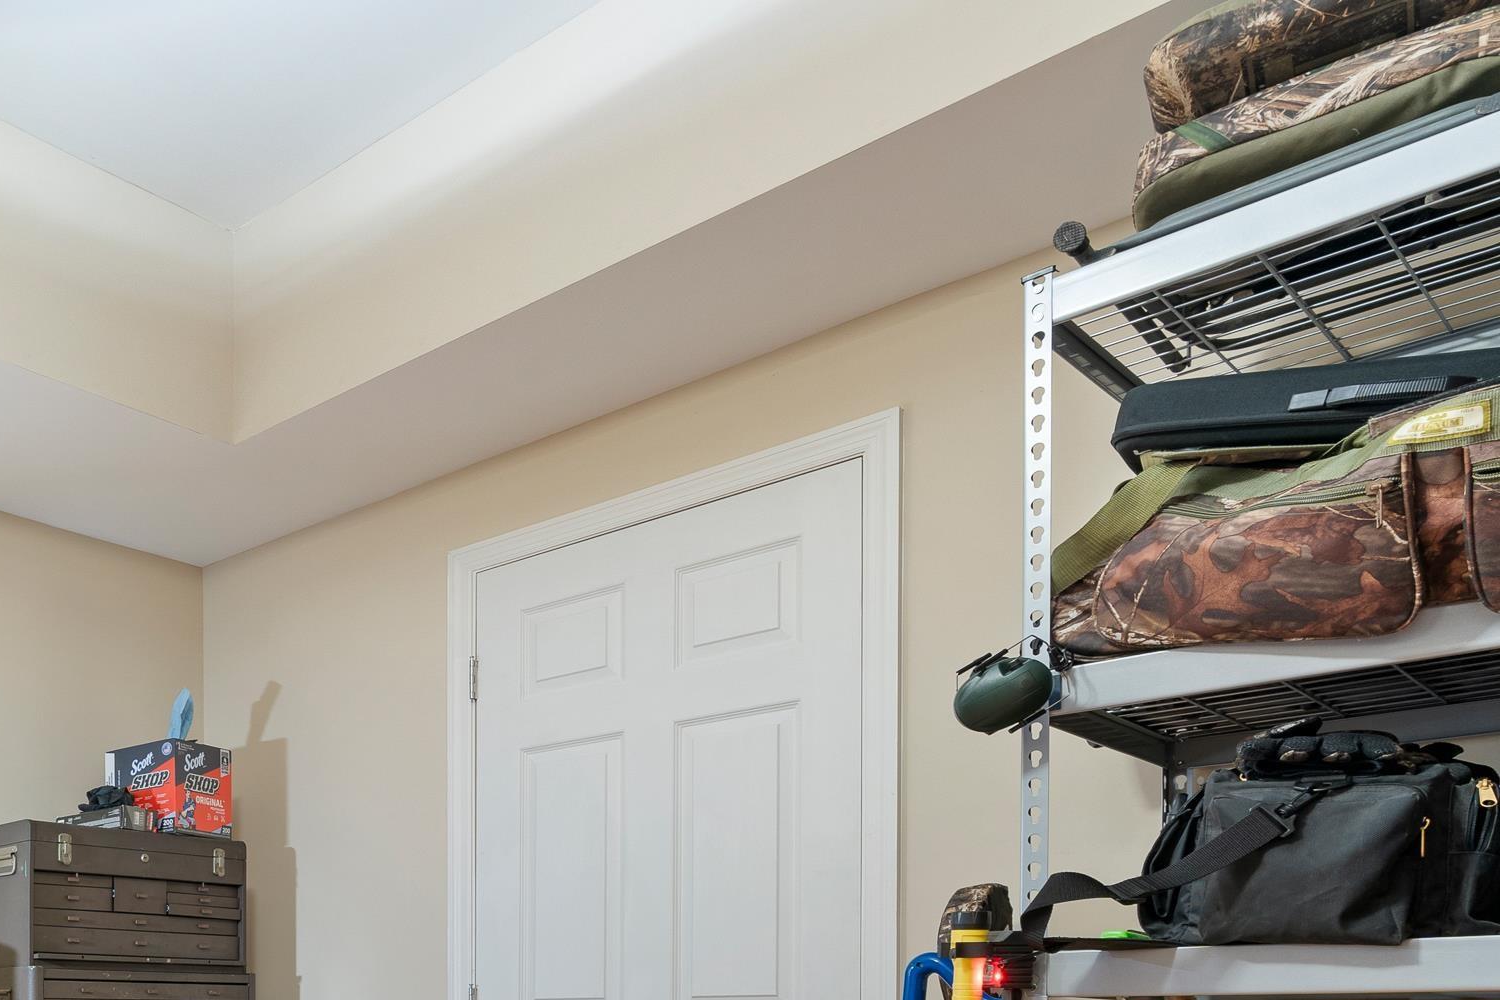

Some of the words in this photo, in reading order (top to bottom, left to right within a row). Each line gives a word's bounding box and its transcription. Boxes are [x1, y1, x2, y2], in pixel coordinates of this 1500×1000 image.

[131, 752, 154, 776] Scott
[184, 752, 205, 772] Scott
[130, 770, 169, 791] SHOP
[184, 773, 219, 795] SHOP
[196, 795, 223, 808] ORIGINAL
